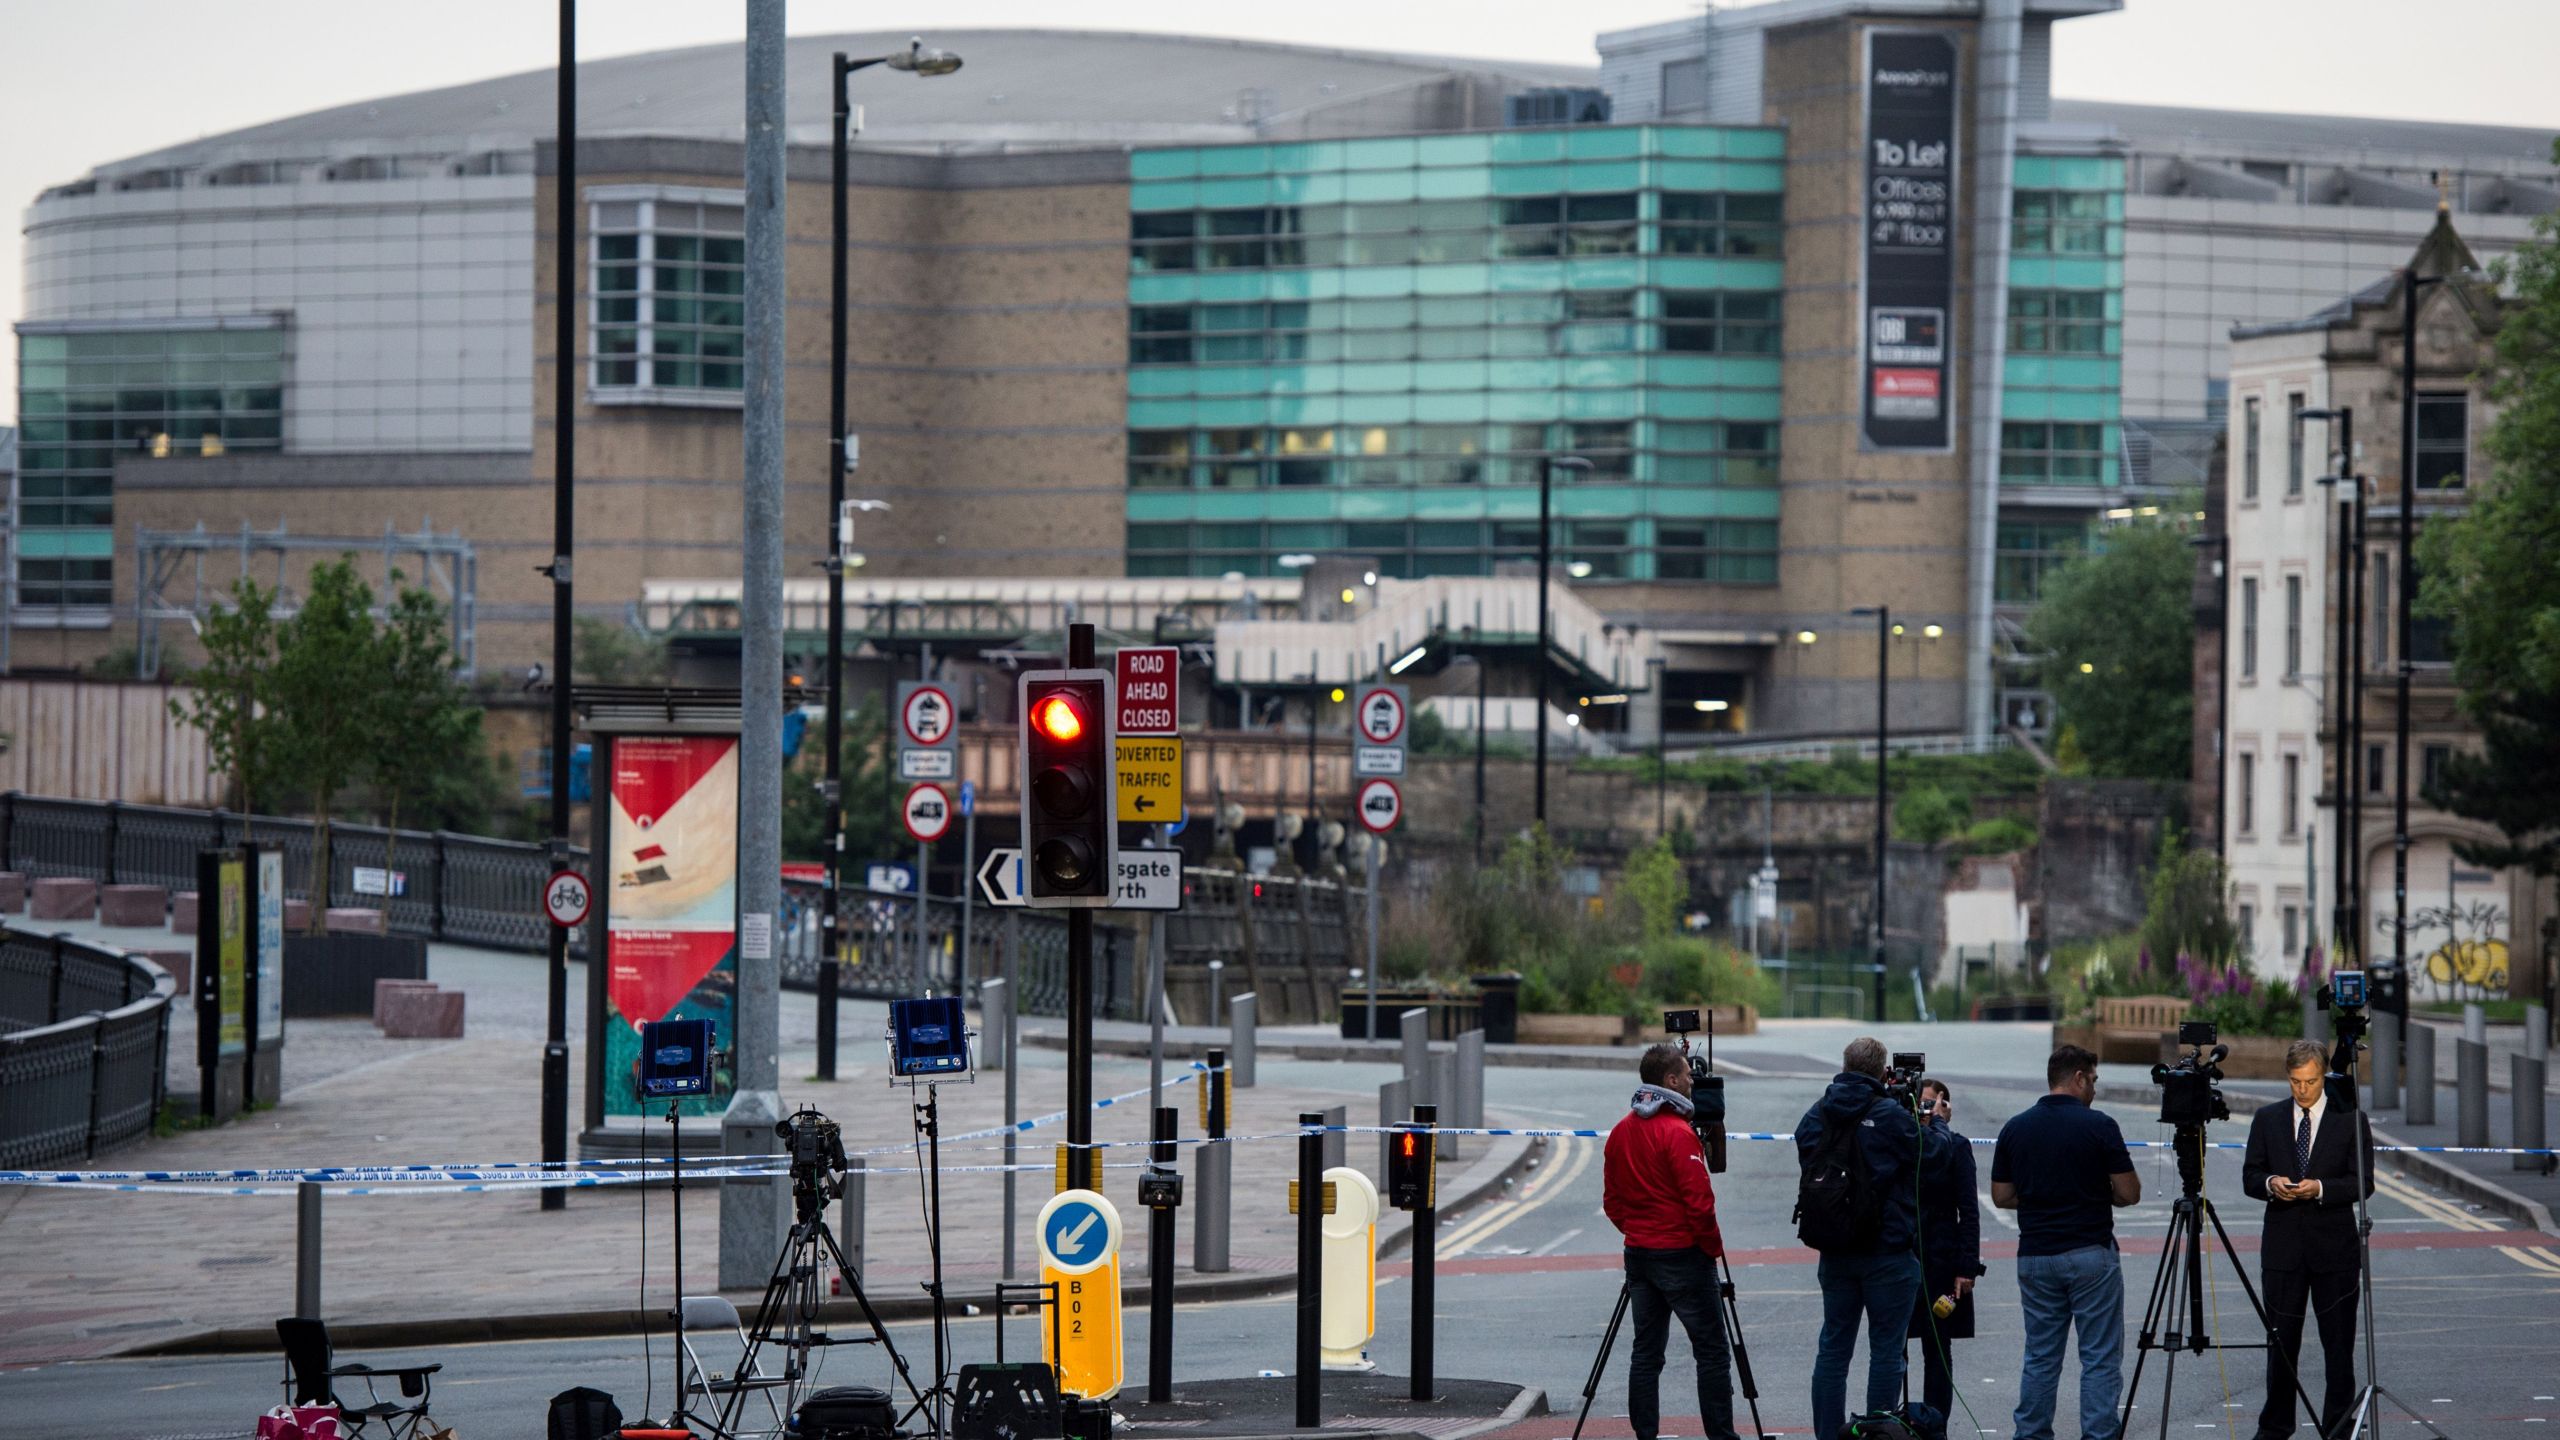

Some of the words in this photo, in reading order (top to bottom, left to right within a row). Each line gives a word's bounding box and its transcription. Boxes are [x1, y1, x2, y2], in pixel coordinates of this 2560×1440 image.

[1874, 139, 1904, 166] To
[1907, 140, 1946, 167] Let
[1873, 175, 1946, 201] Offices
[1130, 655, 1164, 673] ROAD
[1126, 682, 1168, 700] AHEAD
[1122, 708, 1171, 727] CLOSED
[1115, 746, 1176, 762] DIVERTED
[1119, 772, 1171, 787] TRAFFIC
[1118, 860, 1170, 880] sgate
[1117, 882, 1146, 899] rth
[335, 1173, 361, 1181] CROSS
[364, 1173, 378, 1181] NOT
[395, 1172, 412, 1180] LINE
[416, 1172, 443, 1180] POLICE
